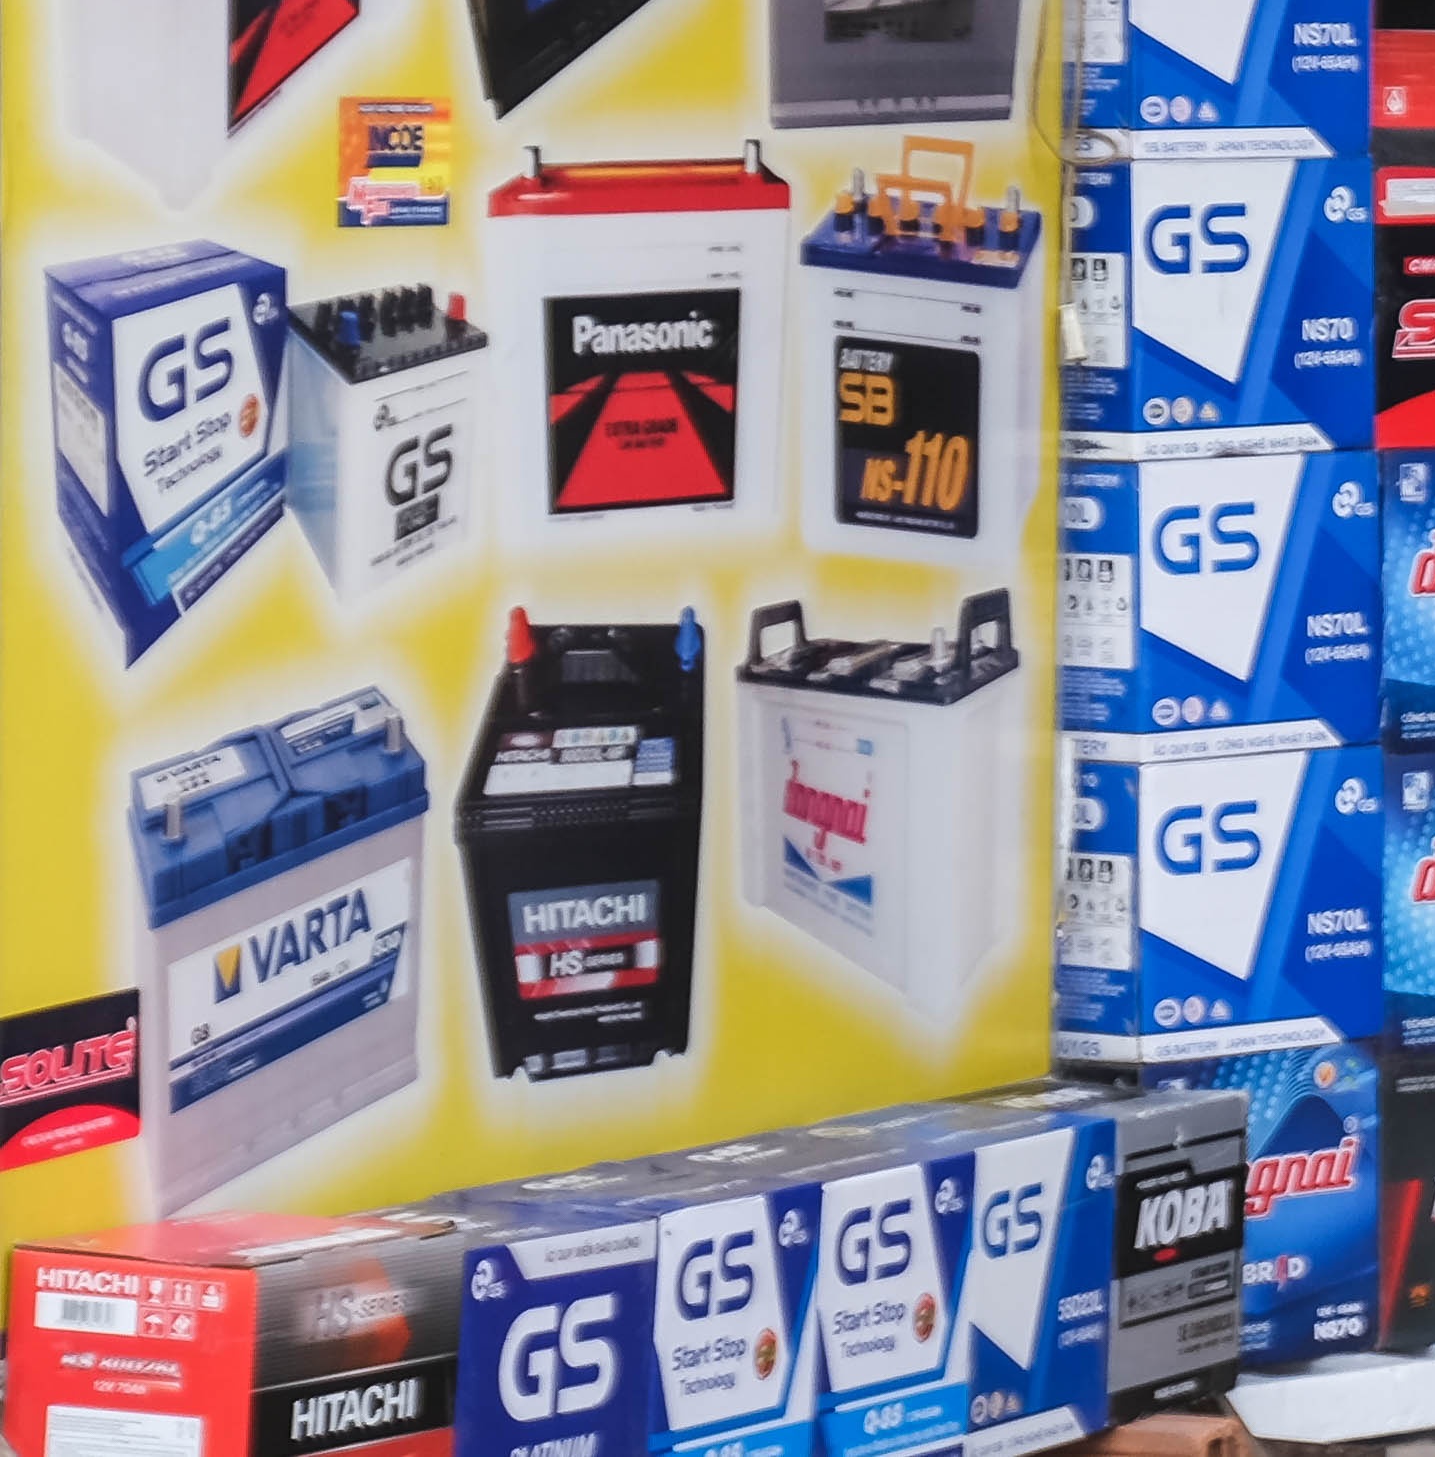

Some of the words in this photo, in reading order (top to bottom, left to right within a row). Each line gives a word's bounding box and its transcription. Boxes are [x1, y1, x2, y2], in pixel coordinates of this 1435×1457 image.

[1142, 203, 1251, 275] GS
[572, 311, 714, 357] Panasonic
[1301, 317, 1354, 343] NS70
[139, 316, 234, 421] GS
[837, 373, 896, 428] SB
[143, 430, 192, 476] Start
[196, 412, 231, 444] Stop
[245, 887, 372, 986] VARTA
[1307, 908, 1369, 936] NS70L
[2, 1029, 136, 1096] SOLITE
[981, 1183, 1042, 1260] GS
[1135, 1178, 1234, 1249] KOBA
[832, 1307, 868, 1336] Start
[872, 1301, 905, 1329] Stop
[841, 1334, 896, 1359] Technology
[291, 1377, 421, 1440] HITACHI
